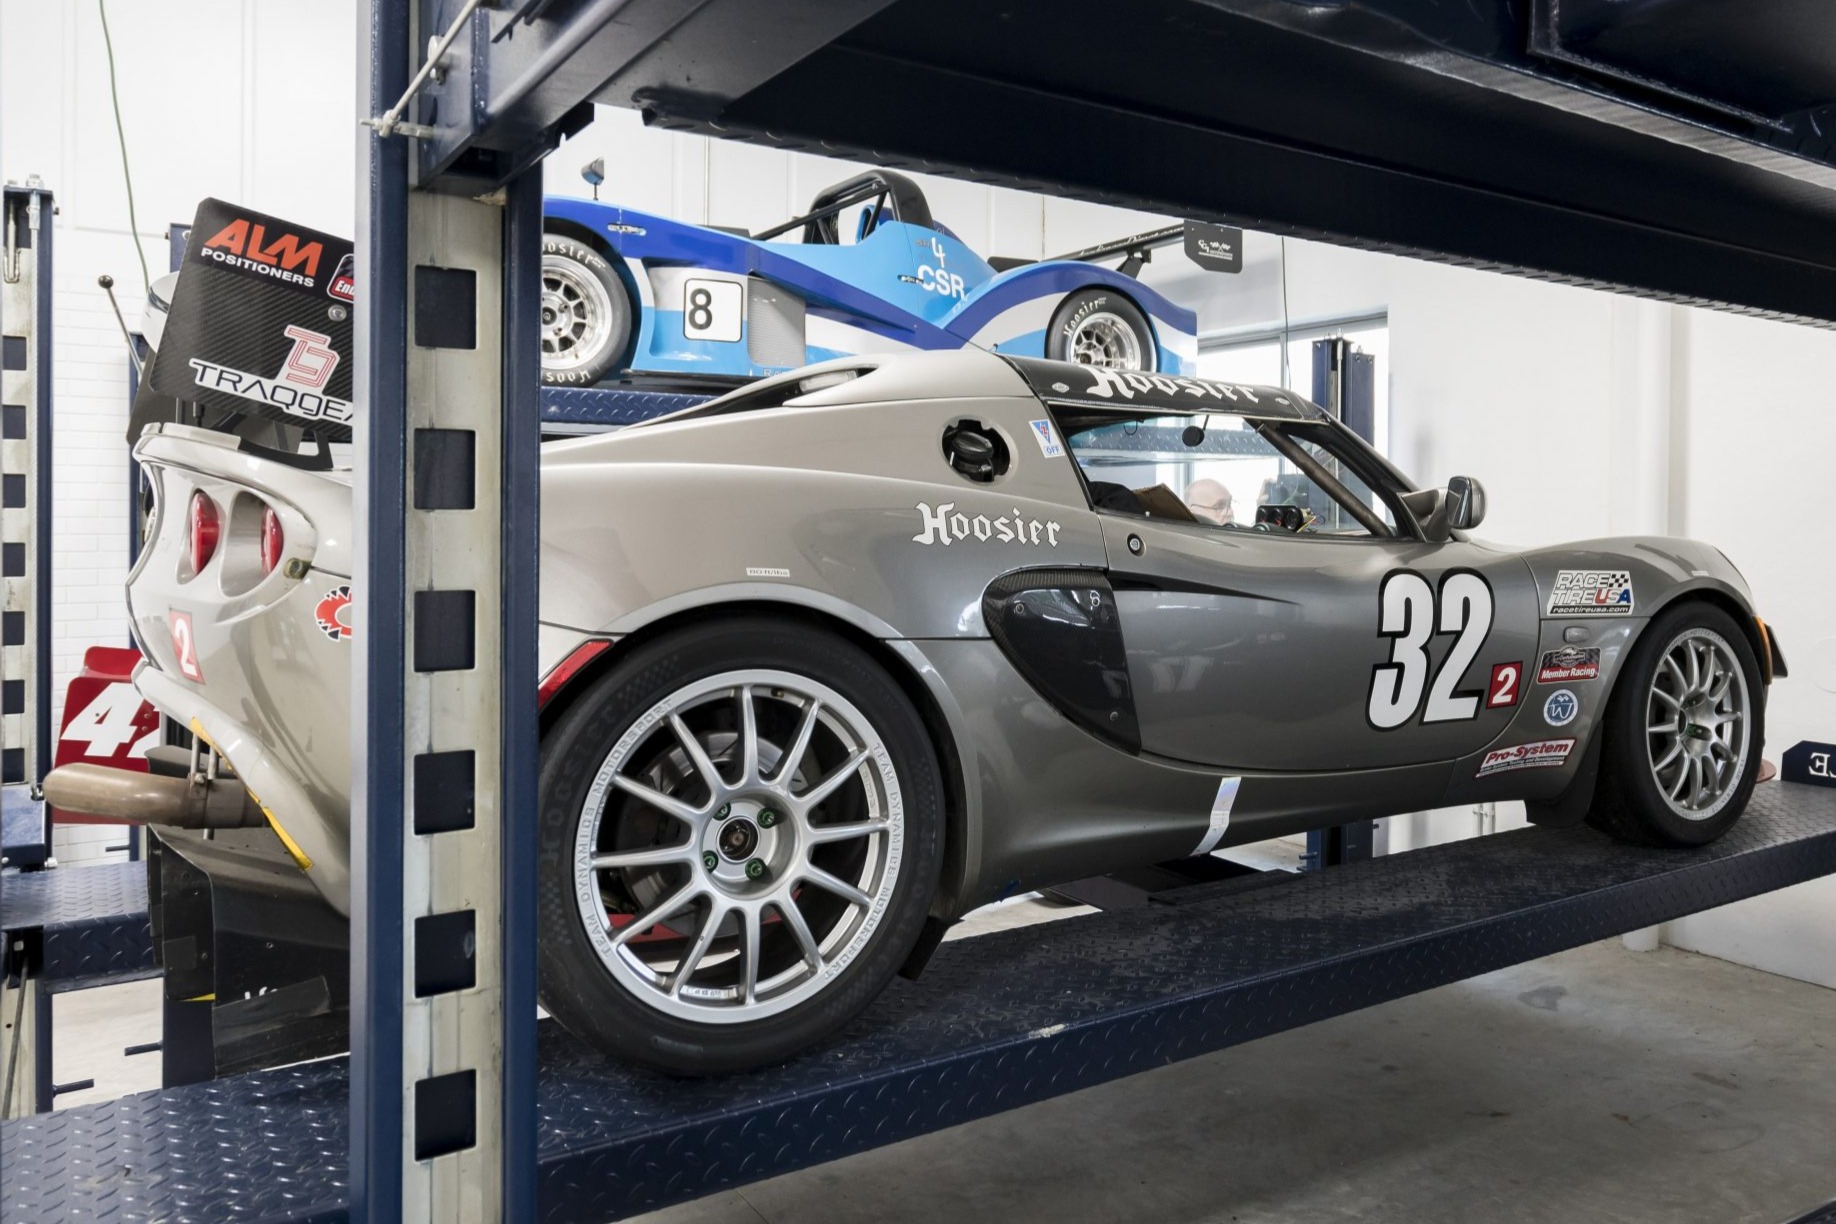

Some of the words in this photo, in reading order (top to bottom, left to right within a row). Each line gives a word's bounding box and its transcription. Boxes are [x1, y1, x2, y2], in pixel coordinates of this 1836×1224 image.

[200, 247, 315, 288] POSITIONERS
[204, 218, 323, 277] ALM
[917, 264, 966, 301] CSR
[688, 288, 712, 330] 8
[1083, 366, 1259, 404] Hoosier
[1045, 445, 1060, 455] OFF
[912, 502, 1061, 548] Hoosier
[1556, 572, 1611, 589] RACE
[1552, 605, 1629, 614] racetireusa.com
[174, 617, 198, 676] 2
[1366, 569, 1495, 731] 32
[1492, 666, 1517, 704] 2
[1541, 668, 1570, 679] Member
[1570, 666, 1596, 678] Racing
[593, 697, 675, 799] MOTORSPORT
[872, 741, 897, 786] TEAM
[1485, 743, 1569, 764] Pro-System
[577, 803, 597, 905] DYNAMICS
[887, 790, 902, 880] DYNAMICS
[580, 911, 614, 960] TEAM
[823, 886, 891, 983] MOTORSPORT
